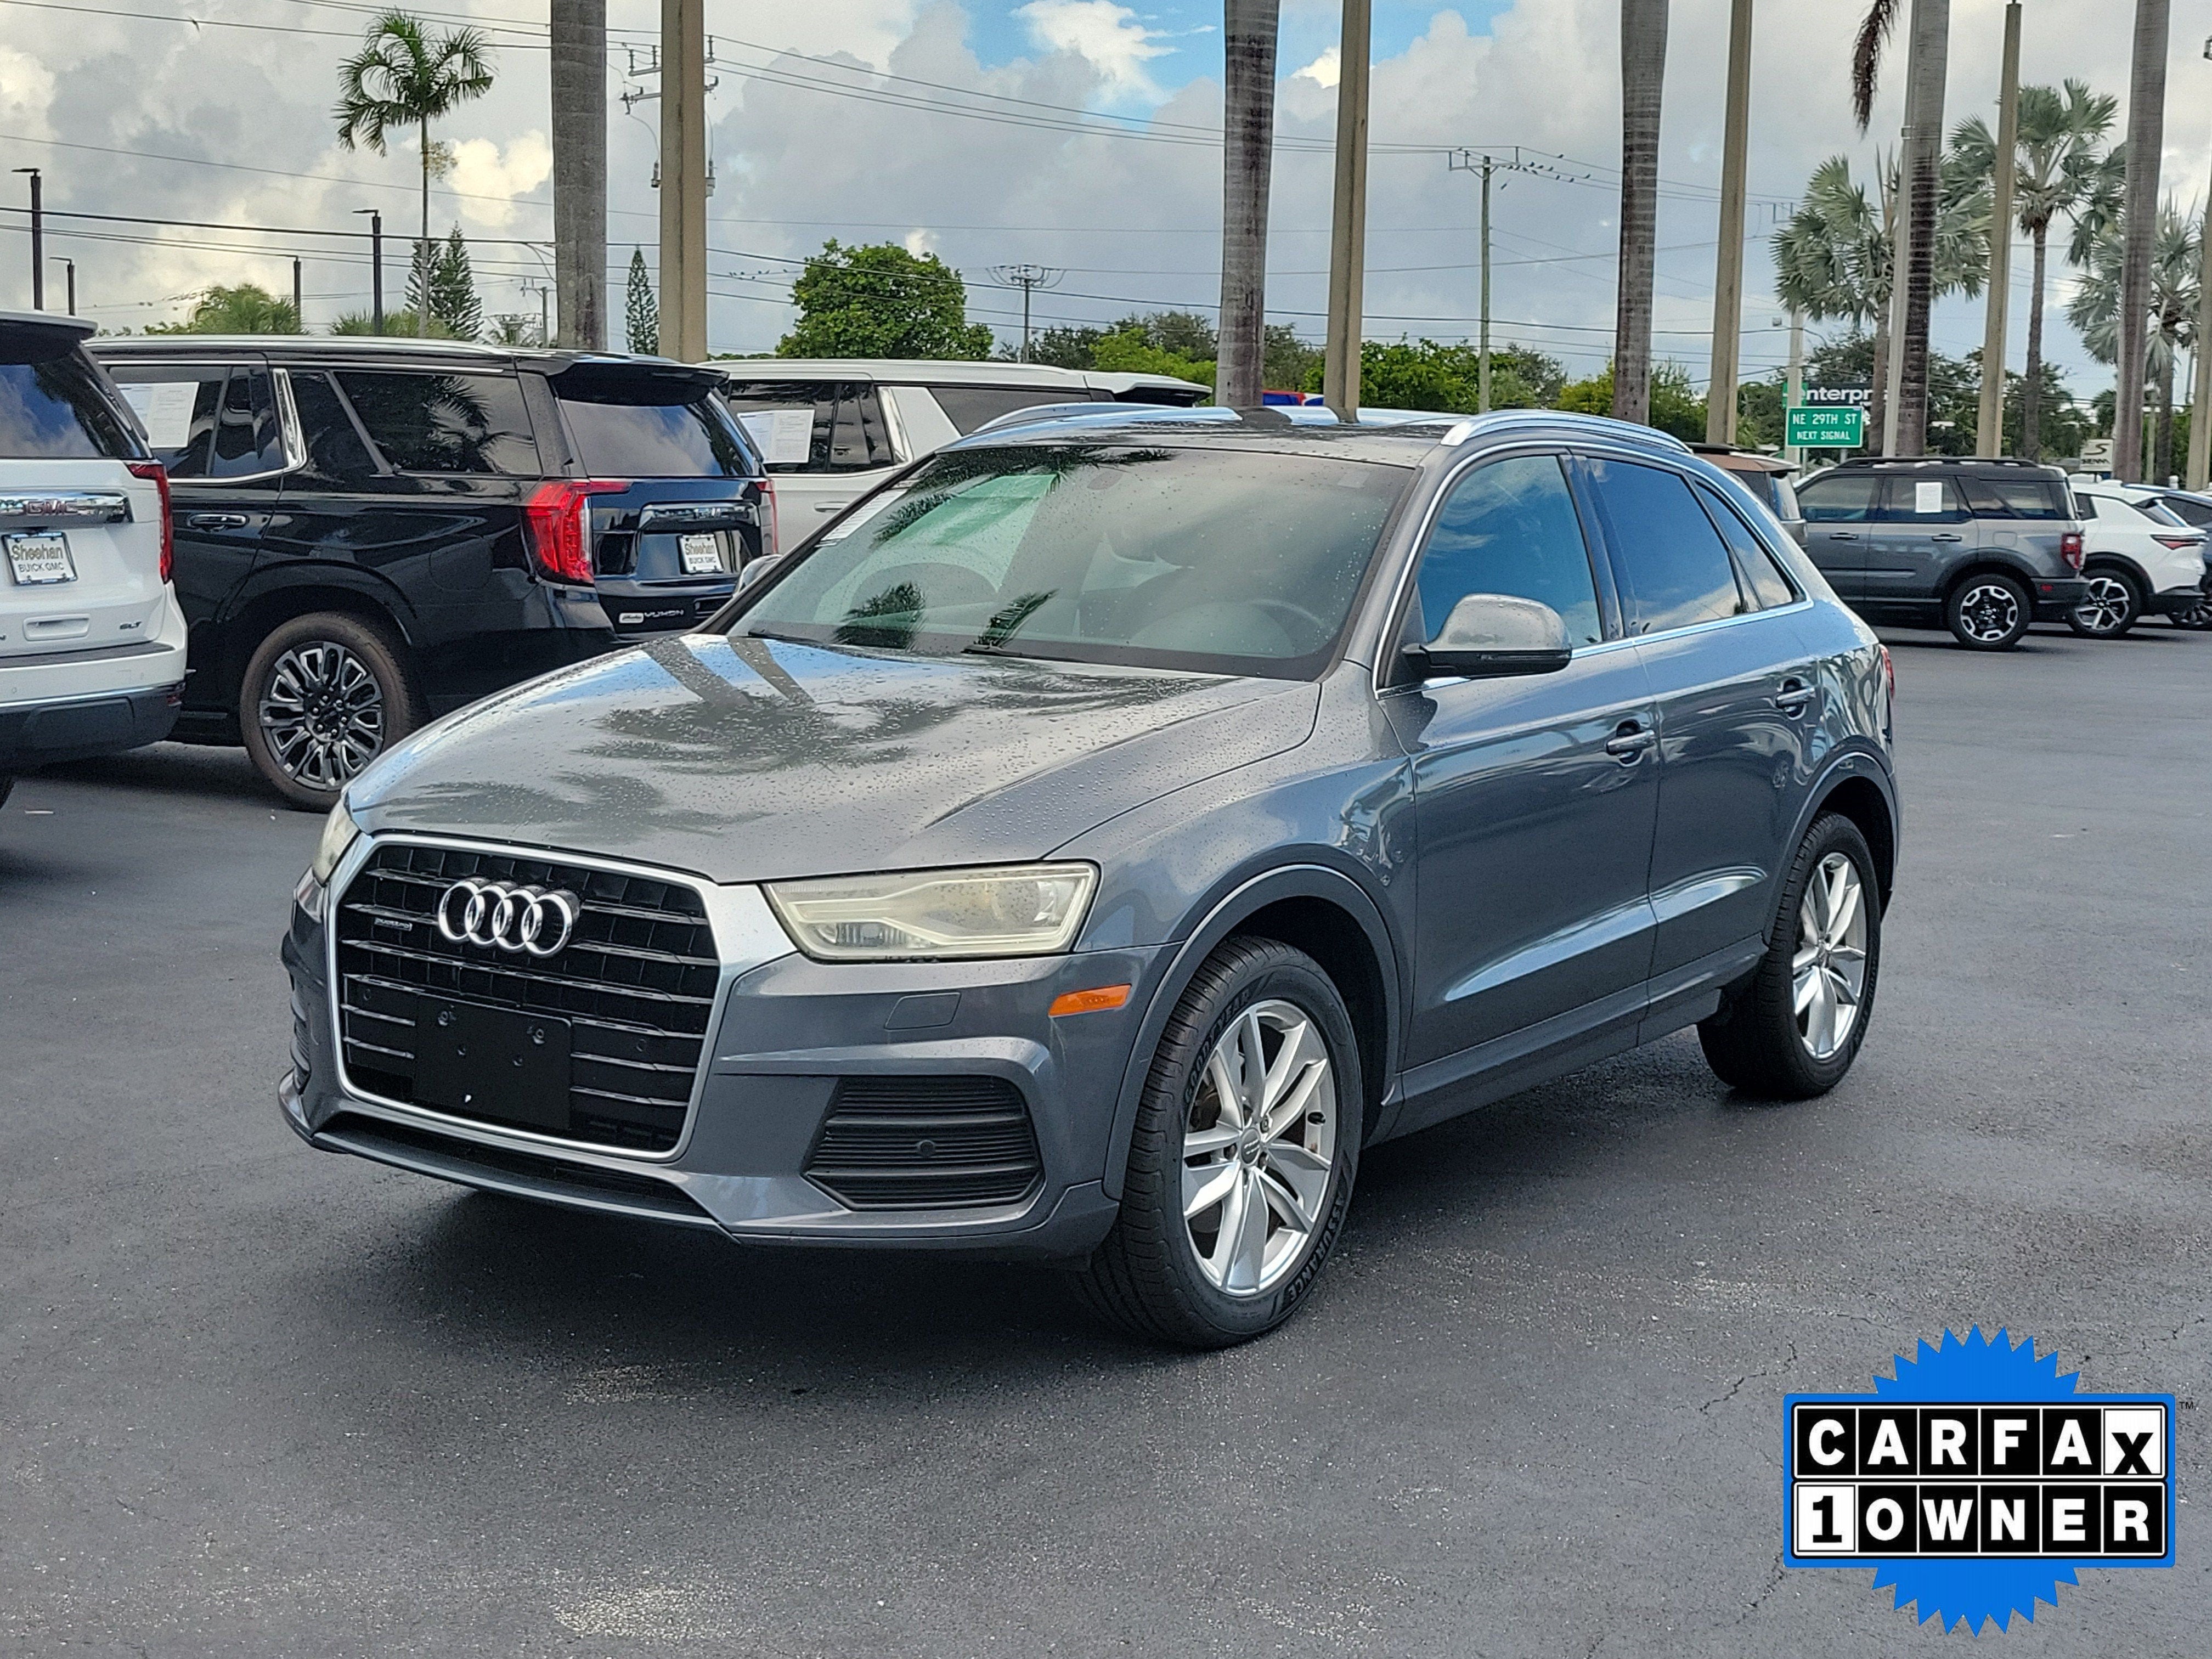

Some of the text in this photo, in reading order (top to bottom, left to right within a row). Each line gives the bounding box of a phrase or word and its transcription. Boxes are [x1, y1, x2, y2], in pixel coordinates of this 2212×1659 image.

[1792, 414, 1807, 425] NE
[1812, 414, 1838, 425] 29TH
[1844, 413, 1858, 425] ST
[1797, 431, 1851, 440] NEXT SIGNAL
[27, 499, 78, 516] GMC
[11, 543, 64, 561] Sheehan
[18, 562, 65, 573] BUICK GMC
[1184, 989, 1253, 1104] GOODYEAR
[1289, 1188, 1345, 1301] ASSURANCE
